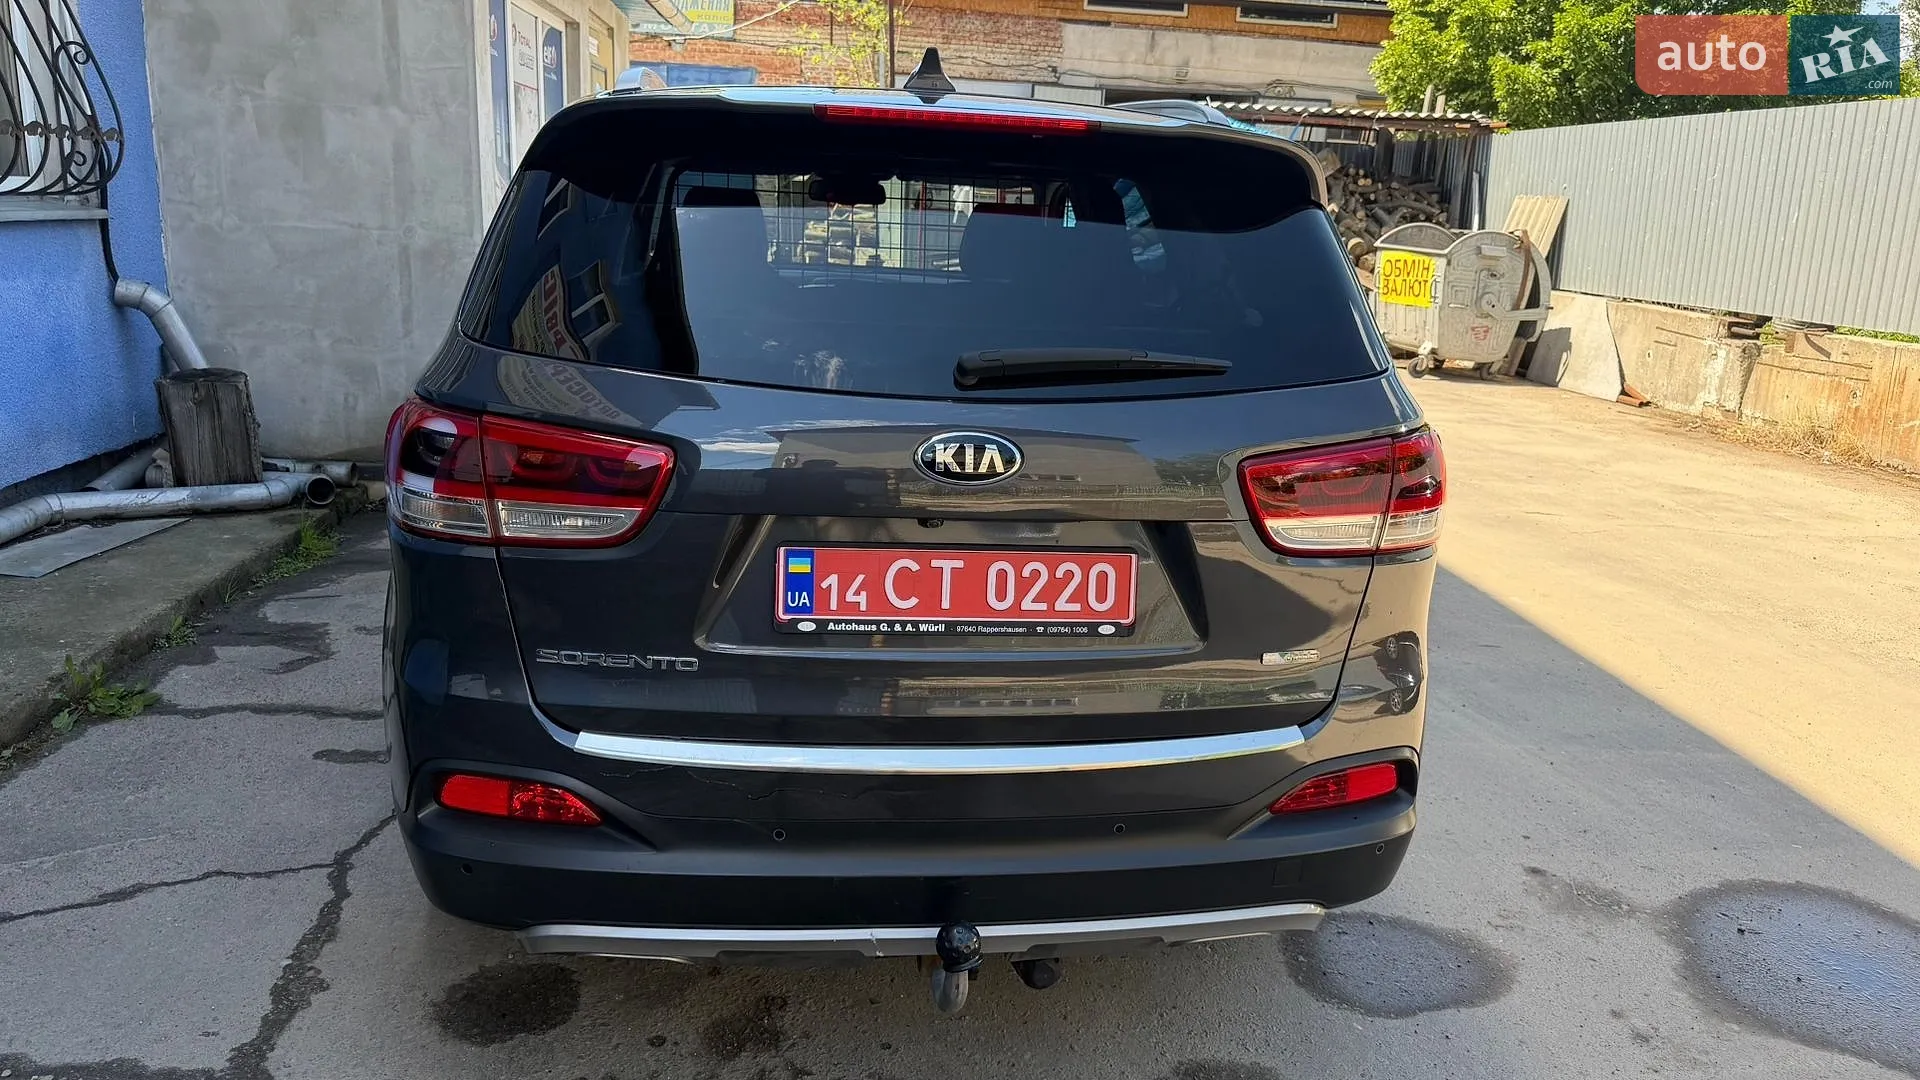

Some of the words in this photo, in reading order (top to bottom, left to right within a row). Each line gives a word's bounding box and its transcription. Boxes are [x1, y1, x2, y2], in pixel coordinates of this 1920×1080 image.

[1382, 258, 1432, 279] ОБМІН
[934, 443, 1005, 473] KIA
[819, 574, 868, 612] 14
[883, 558, 965, 611] CT
[985, 560, 1117, 612] 0220
[787, 591, 811, 608] UA
[827, 622, 877, 632] Autohaus
[879, 623, 891, 632] G.
[893, 623, 902, 632] &
[904, 623, 916, 632] A.
[535, 648, 699, 672] SORENTO
